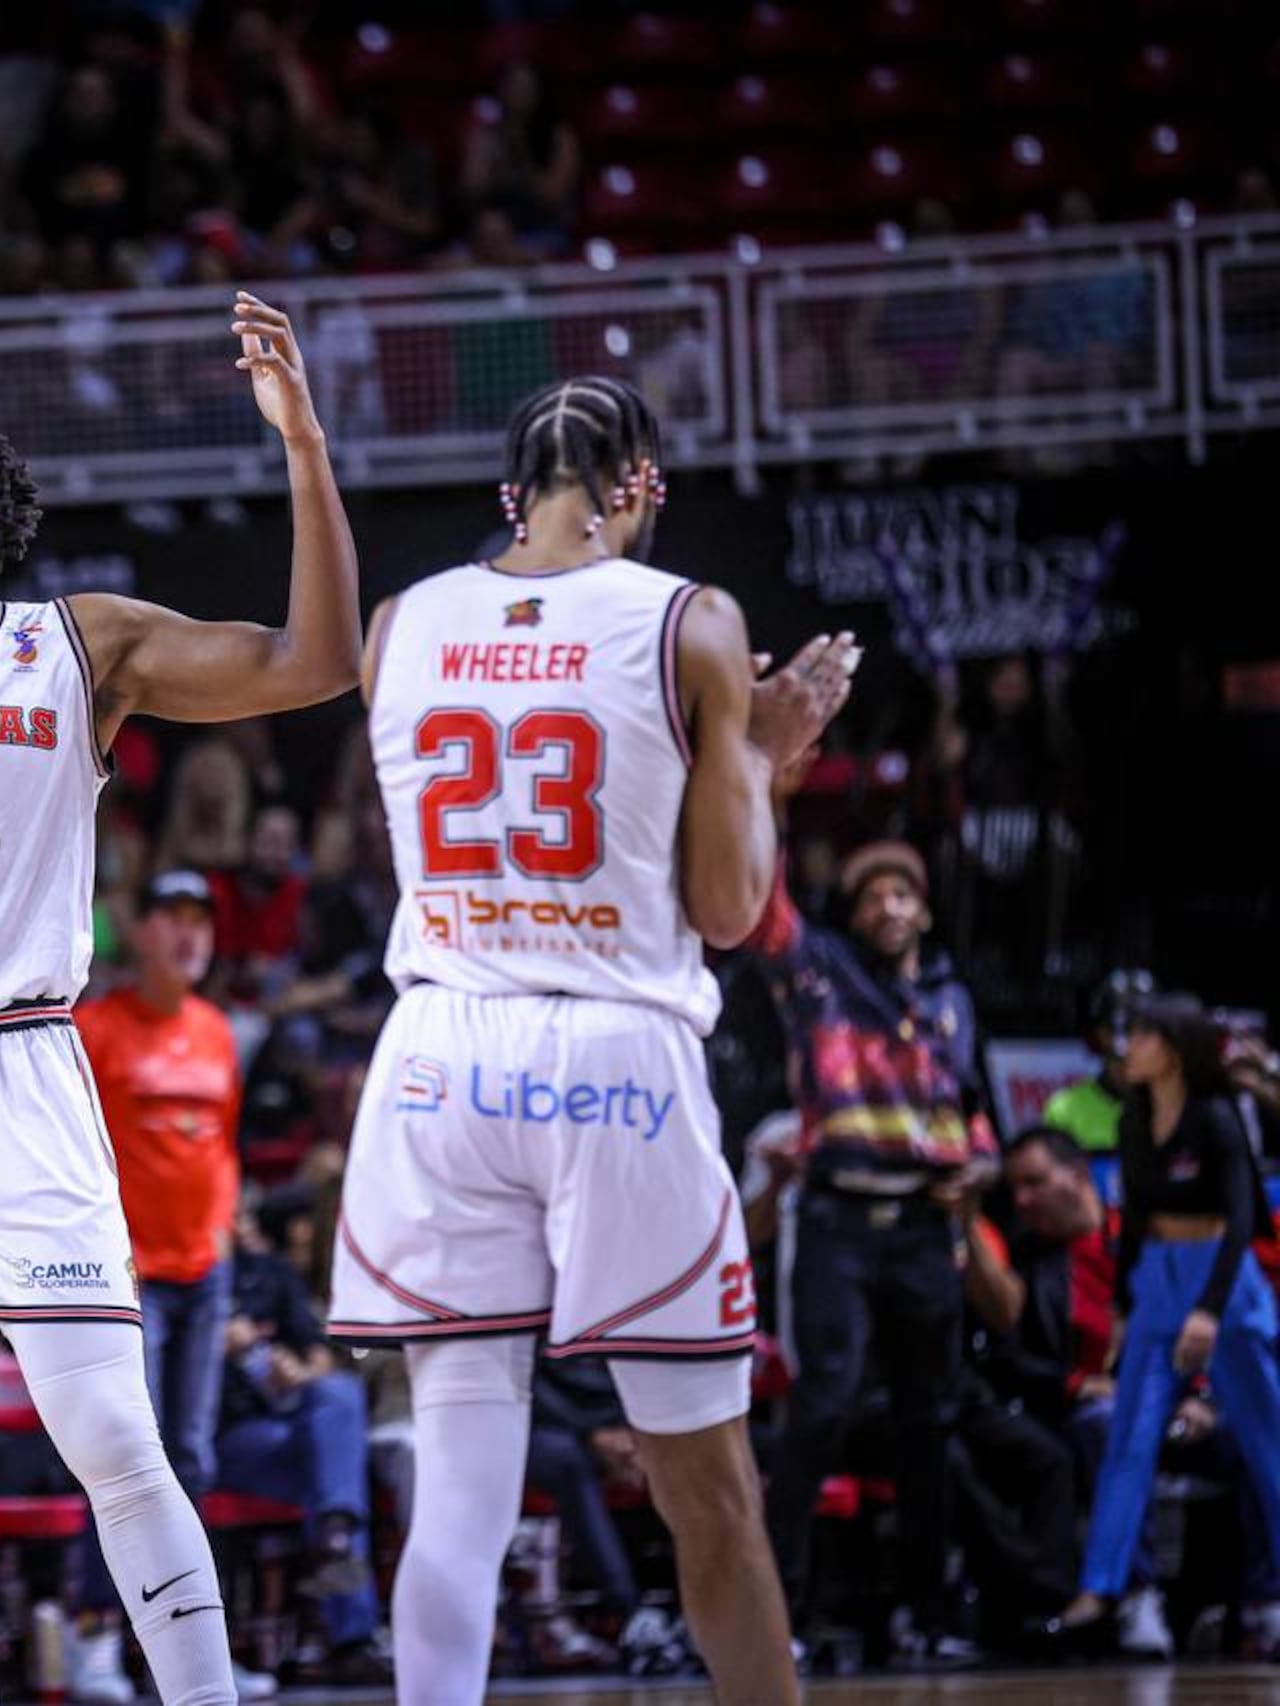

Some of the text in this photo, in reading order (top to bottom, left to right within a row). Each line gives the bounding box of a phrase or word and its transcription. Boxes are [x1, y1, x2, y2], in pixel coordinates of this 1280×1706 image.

[441, 643, 589, 682] WHEELER
[414, 707, 607, 883] 23
[467, 890, 621, 929] brava
[471, 1064, 675, 1141] Liberty
[32, 1263, 103, 1278] CAMUY
[720, 1257, 756, 1328] 2
